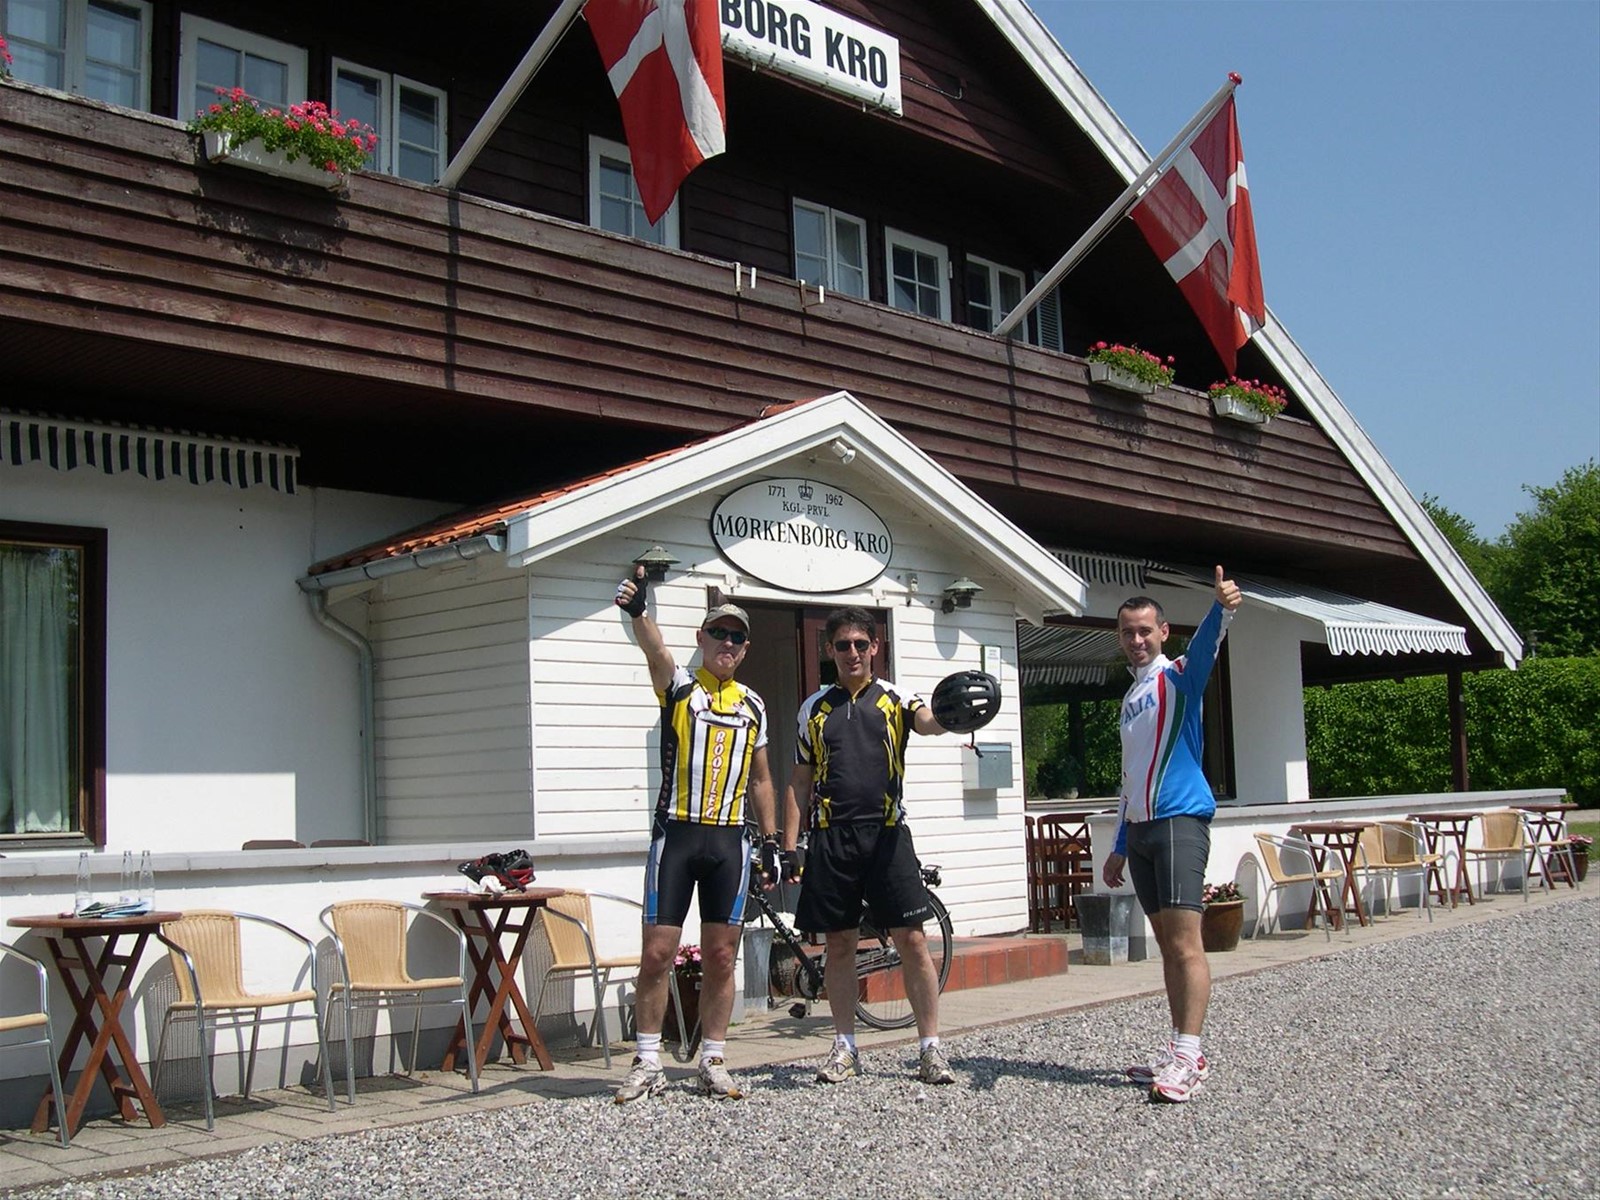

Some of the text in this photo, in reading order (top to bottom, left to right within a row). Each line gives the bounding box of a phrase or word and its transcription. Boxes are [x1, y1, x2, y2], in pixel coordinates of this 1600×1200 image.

[721, 0, 888, 89] BORG KRO
[768, 485, 786, 498] 1771
[825, 493, 844, 506] 1962
[715, 514, 889, 555] MØRKENBORG KRO
